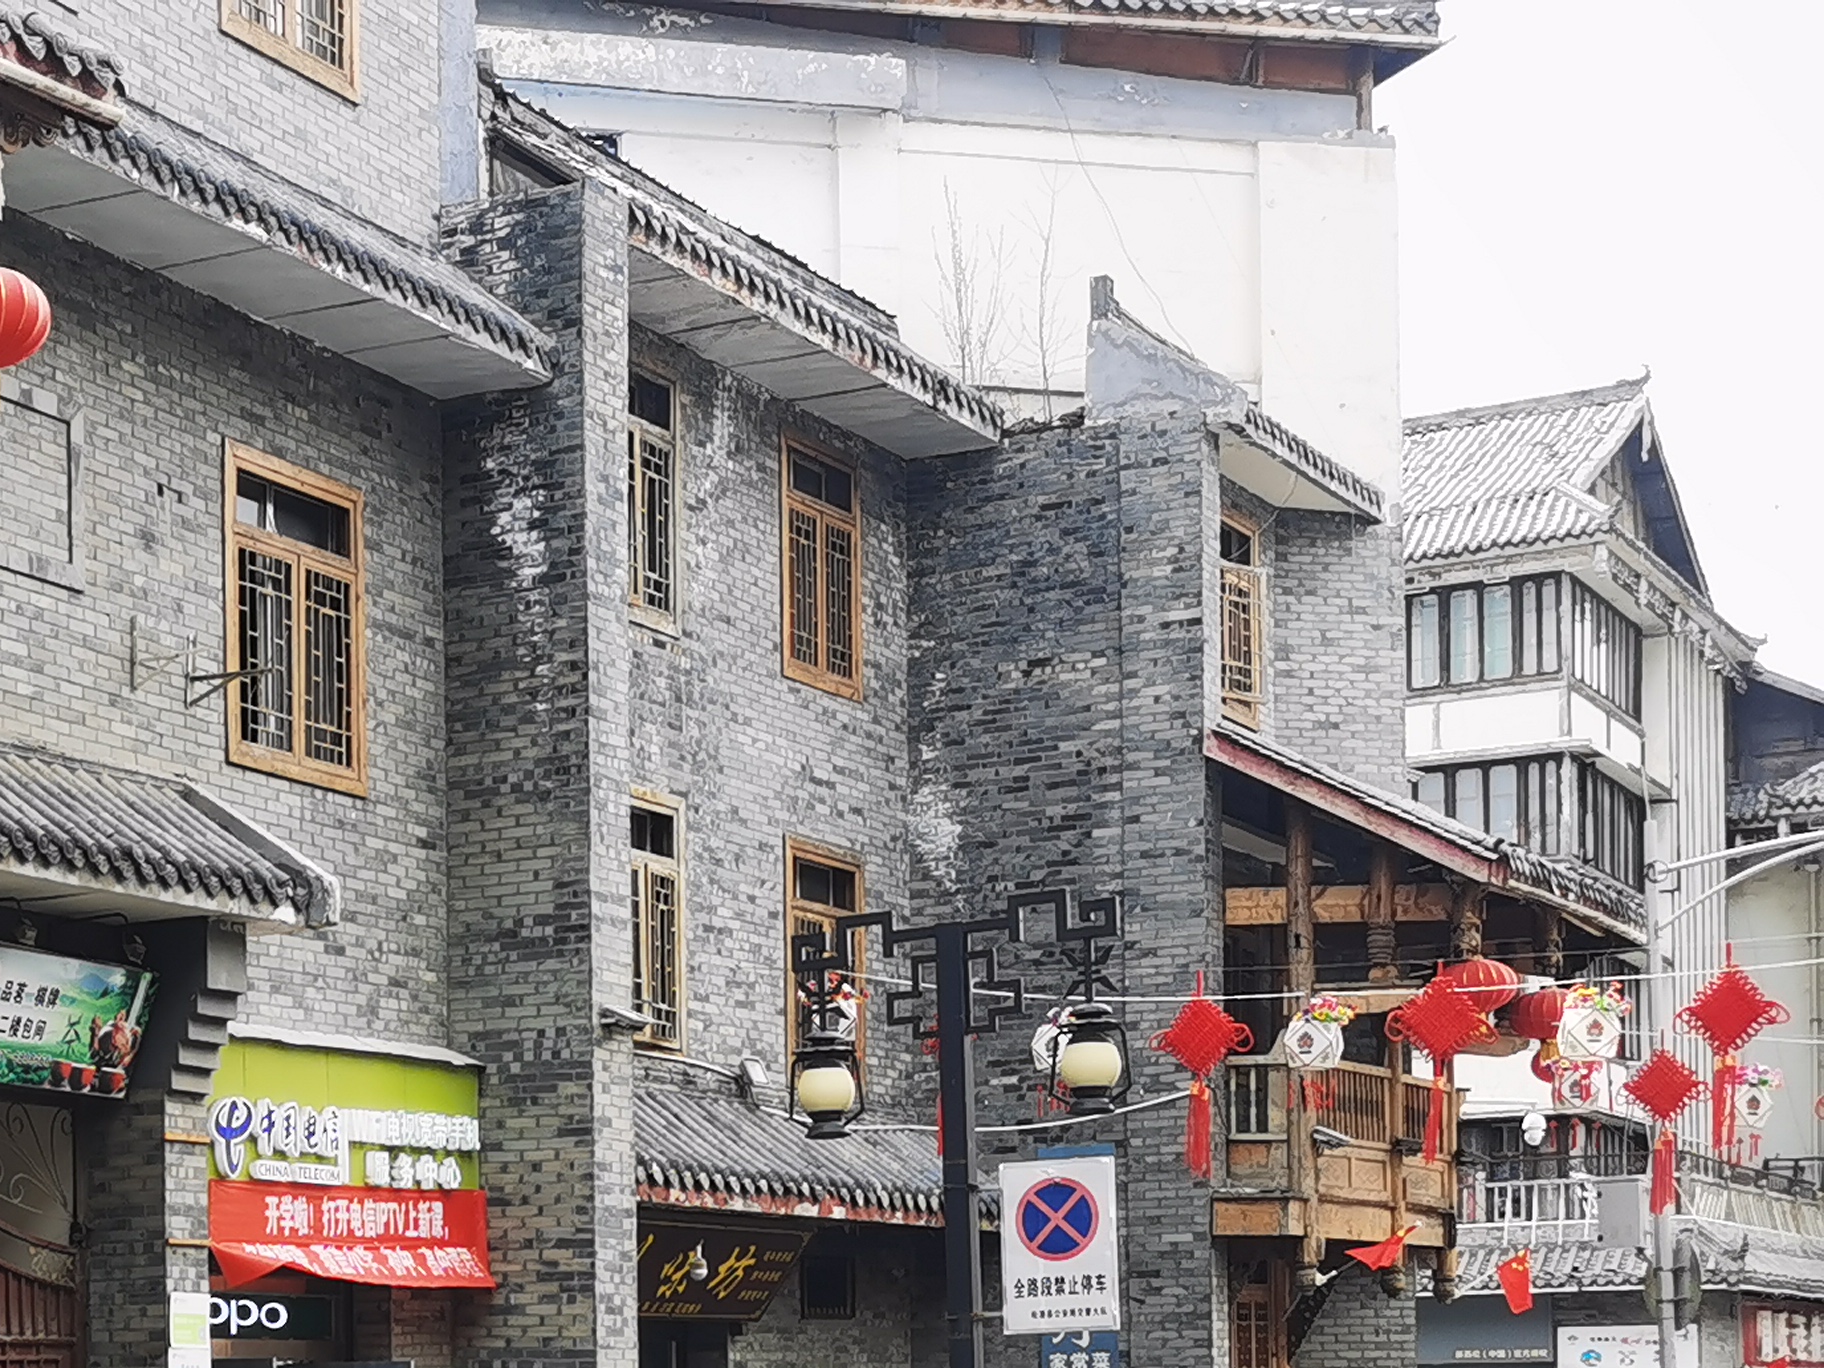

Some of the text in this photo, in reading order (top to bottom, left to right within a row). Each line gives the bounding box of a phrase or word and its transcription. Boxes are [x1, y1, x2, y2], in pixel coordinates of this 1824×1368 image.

[259, 1100, 340, 1153] 中国电信
[257, 1163, 291, 1179] CHINA
[373, 1151, 462, 1190] 服务中心
[1014, 1274, 1107, 1299] 全路段禁止停车
